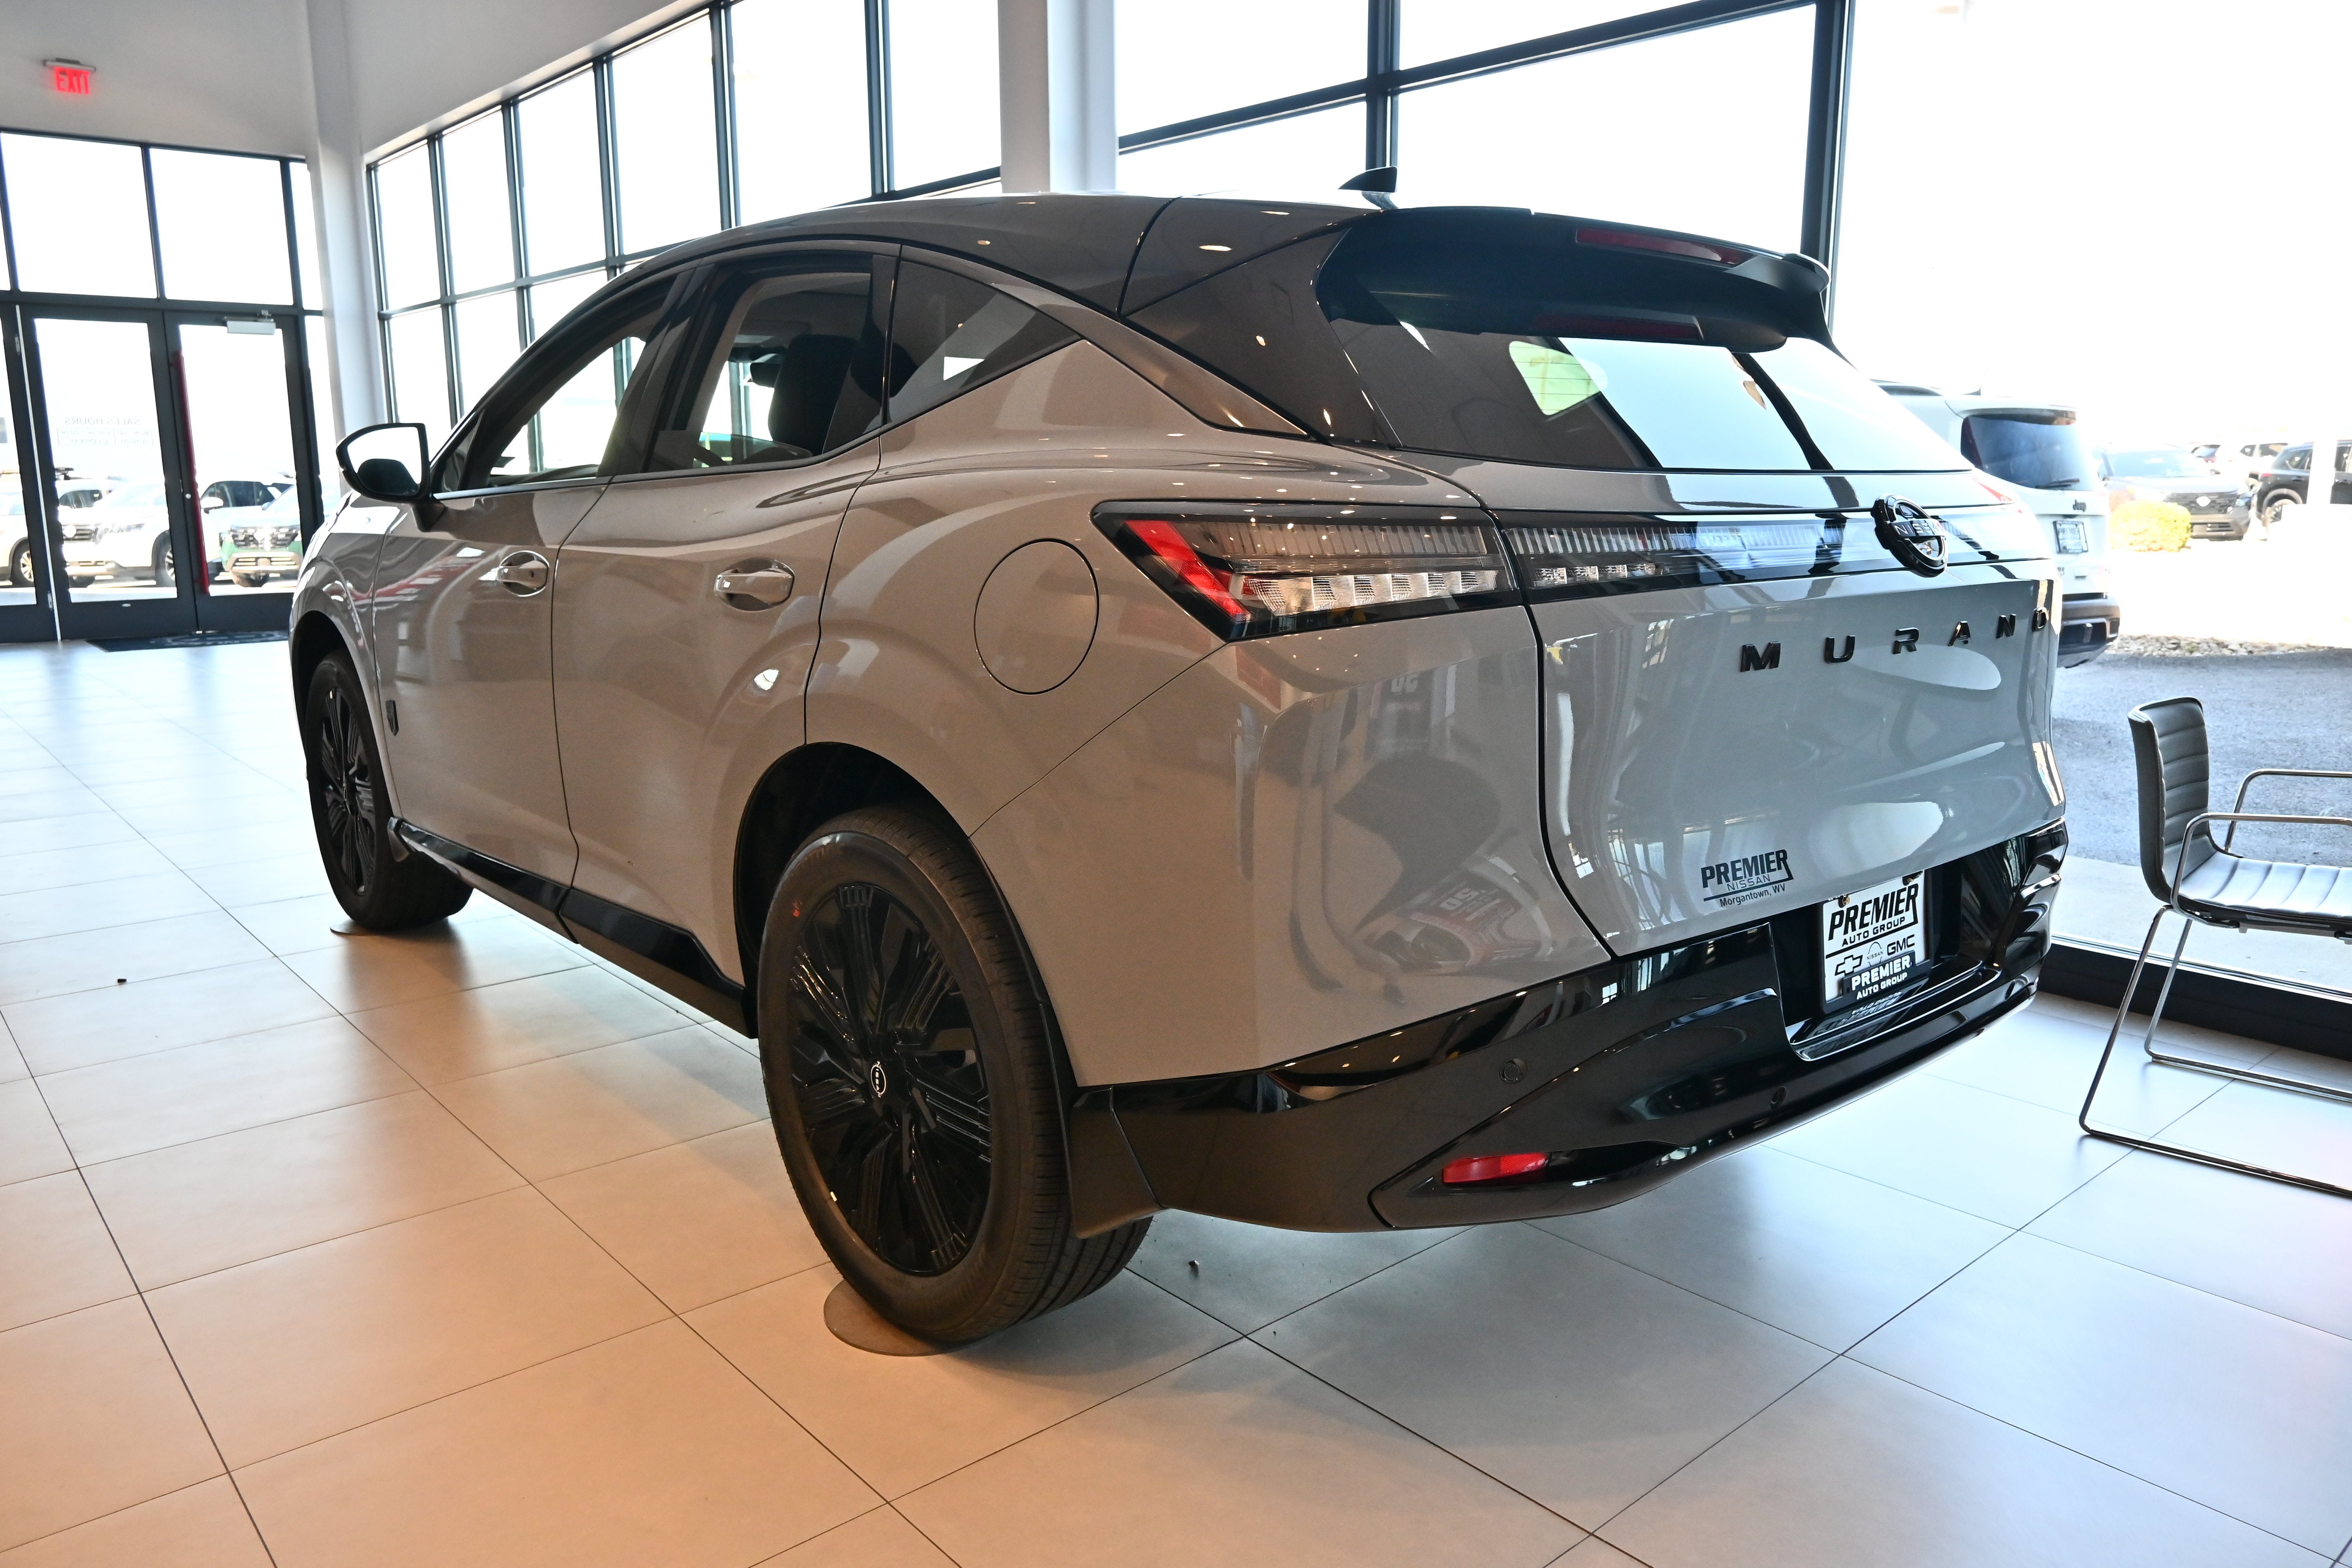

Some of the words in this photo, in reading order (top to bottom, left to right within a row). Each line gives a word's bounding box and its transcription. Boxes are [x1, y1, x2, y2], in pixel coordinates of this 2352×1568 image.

[54, 66, 90, 95] EXIT
[1740, 606, 2048, 672] MURANO
[1701, 849, 1791, 888] PREMIER
[1727, 874, 1771, 891] NISSAN
[1720, 888, 1772, 907] Morgantown,
[1772, 883, 1785, 894] WV
[1828, 883, 1919, 941] PREMIER
[1842, 930, 1869, 947] AUTO
[1873, 916, 1905, 935] GROUP
[1867, 950, 1884, 960] NISSAN
[1887, 934, 1915, 956] GMC
[1852, 955, 1910, 991] PREMIER
[1857, 984, 1879, 999] AUTO
[1880, 972, 1908, 989] GROUP
